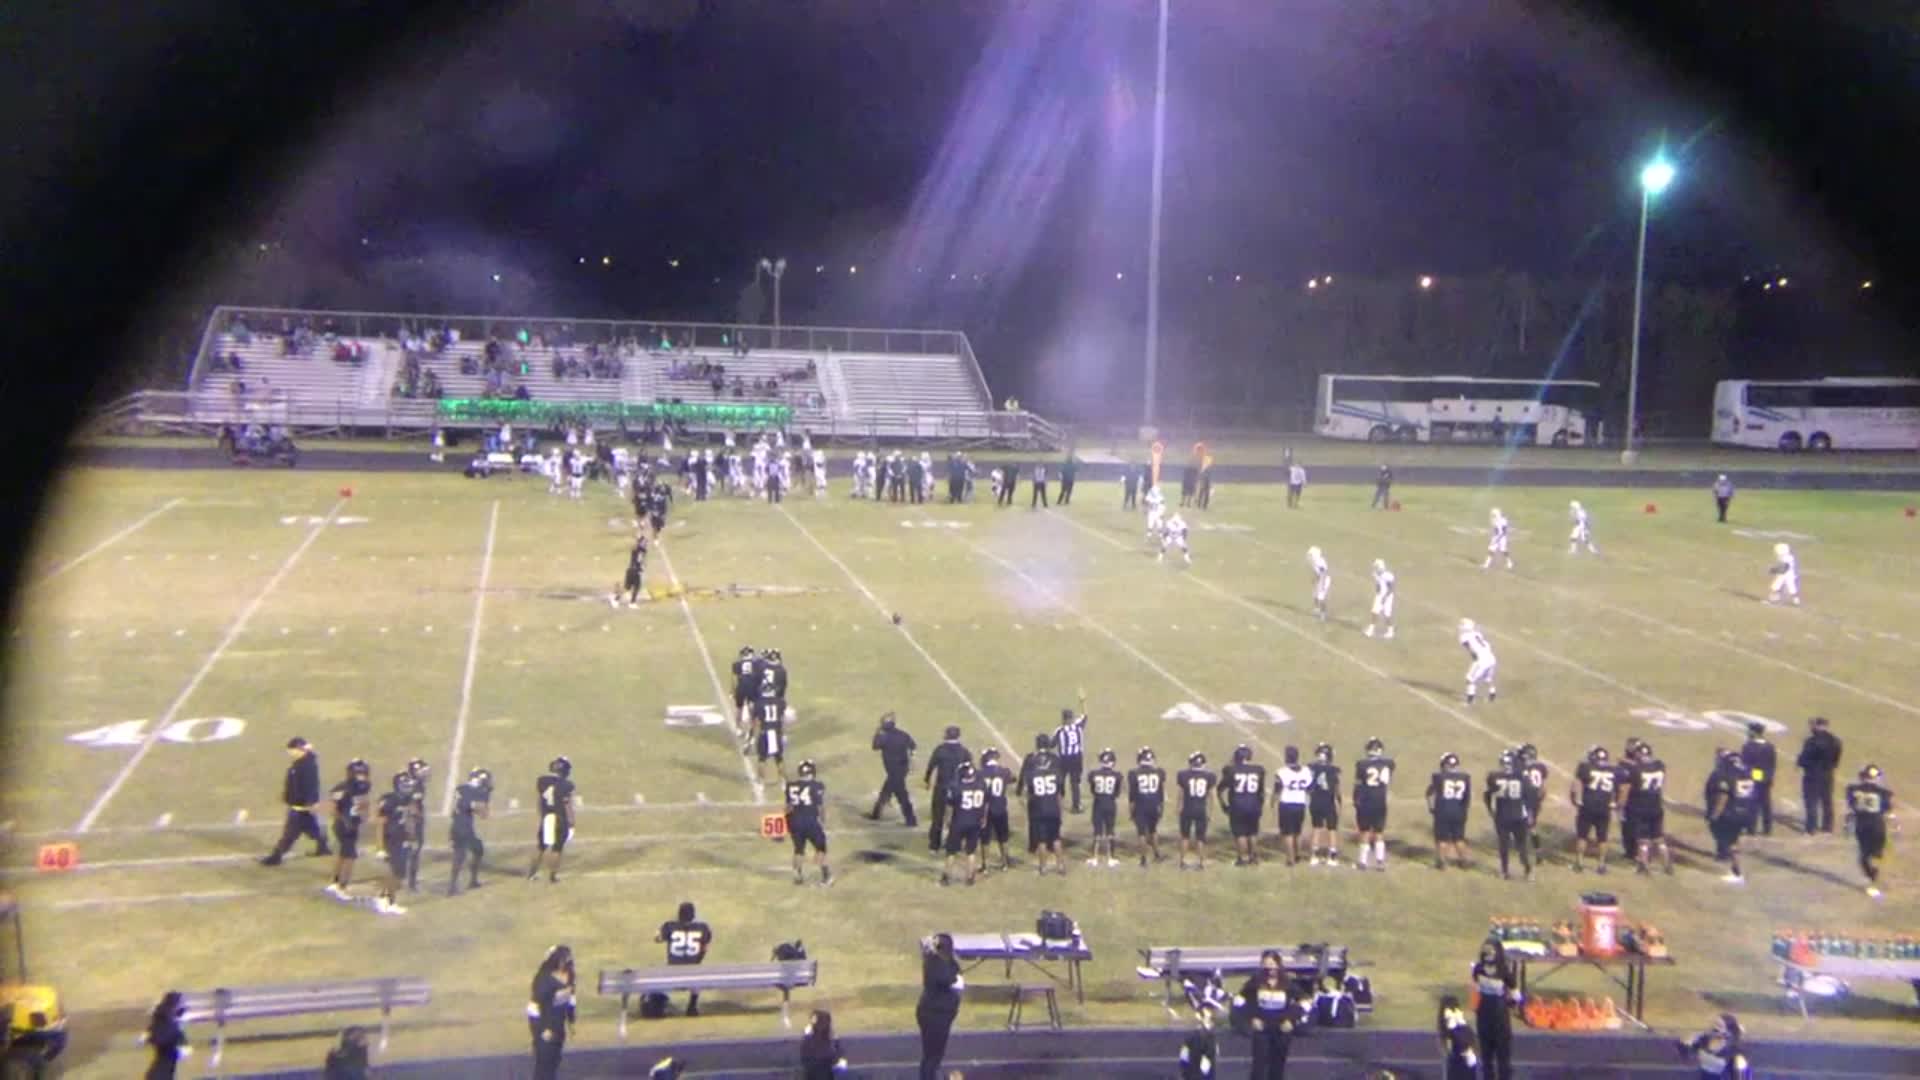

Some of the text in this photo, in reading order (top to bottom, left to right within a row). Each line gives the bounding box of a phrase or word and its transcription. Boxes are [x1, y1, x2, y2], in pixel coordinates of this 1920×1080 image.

[764, 704, 778, 722] 11
[65, 716, 247, 746] 40
[1137, 774, 1160, 794] 20
[1234, 773, 1259, 794] 76
[1366, 766, 1391, 787] 24
[1589, 770, 1616, 793] 75
[788, 786, 812, 806] 54
[960, 790, 985, 811] 50
[764, 817, 784, 835] 50
[669, 930, 702, 957] 25
